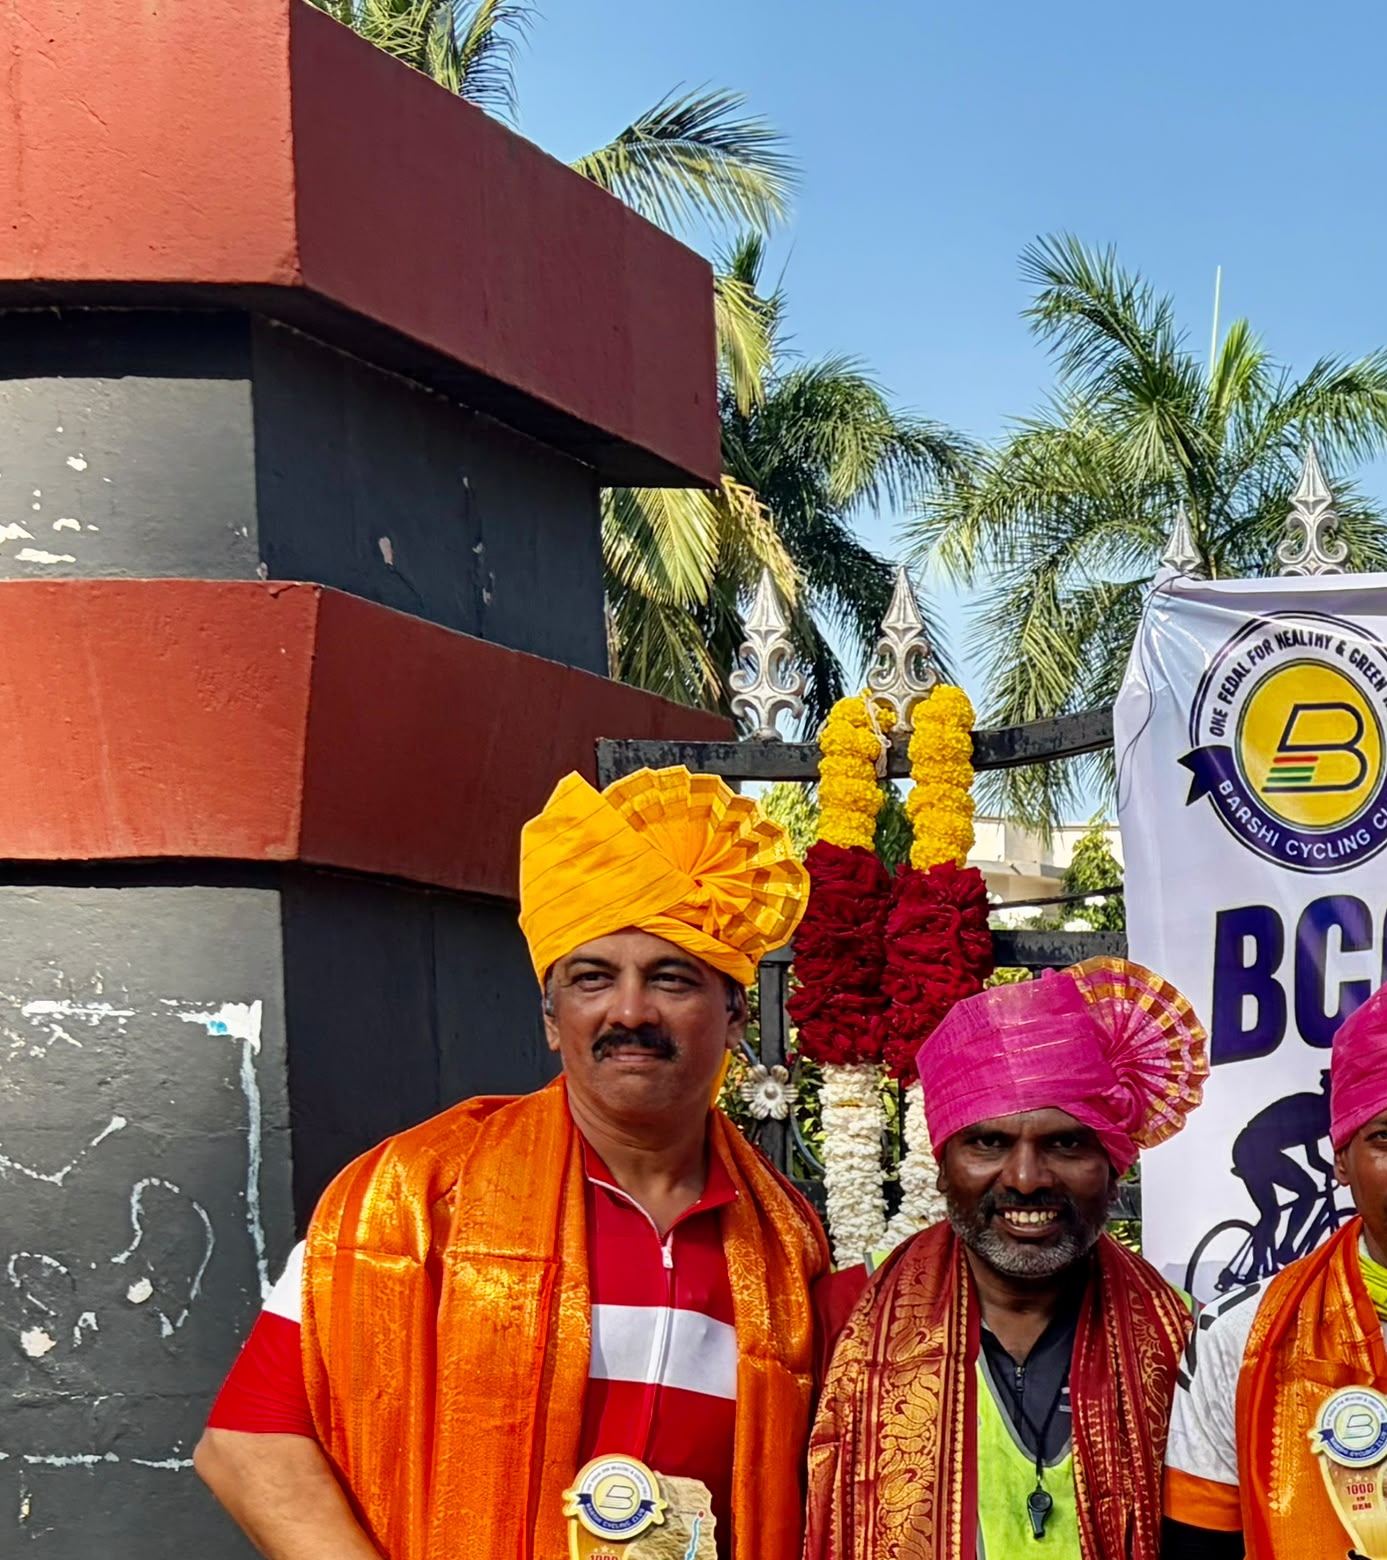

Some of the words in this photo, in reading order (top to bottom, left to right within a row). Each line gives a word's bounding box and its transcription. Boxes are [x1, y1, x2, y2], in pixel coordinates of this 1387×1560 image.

[1247, 639, 1275, 666] FOR
[1275, 629, 1333, 650] HEALTHY
[1335, 640, 1346, 657] &
[1349, 648, 1387, 691] GREEN
[1219, 780, 1280, 847] BARSHI
[1286, 829, 1370, 859] CYCLING
[1346, 1482, 1374, 1495] 1000
